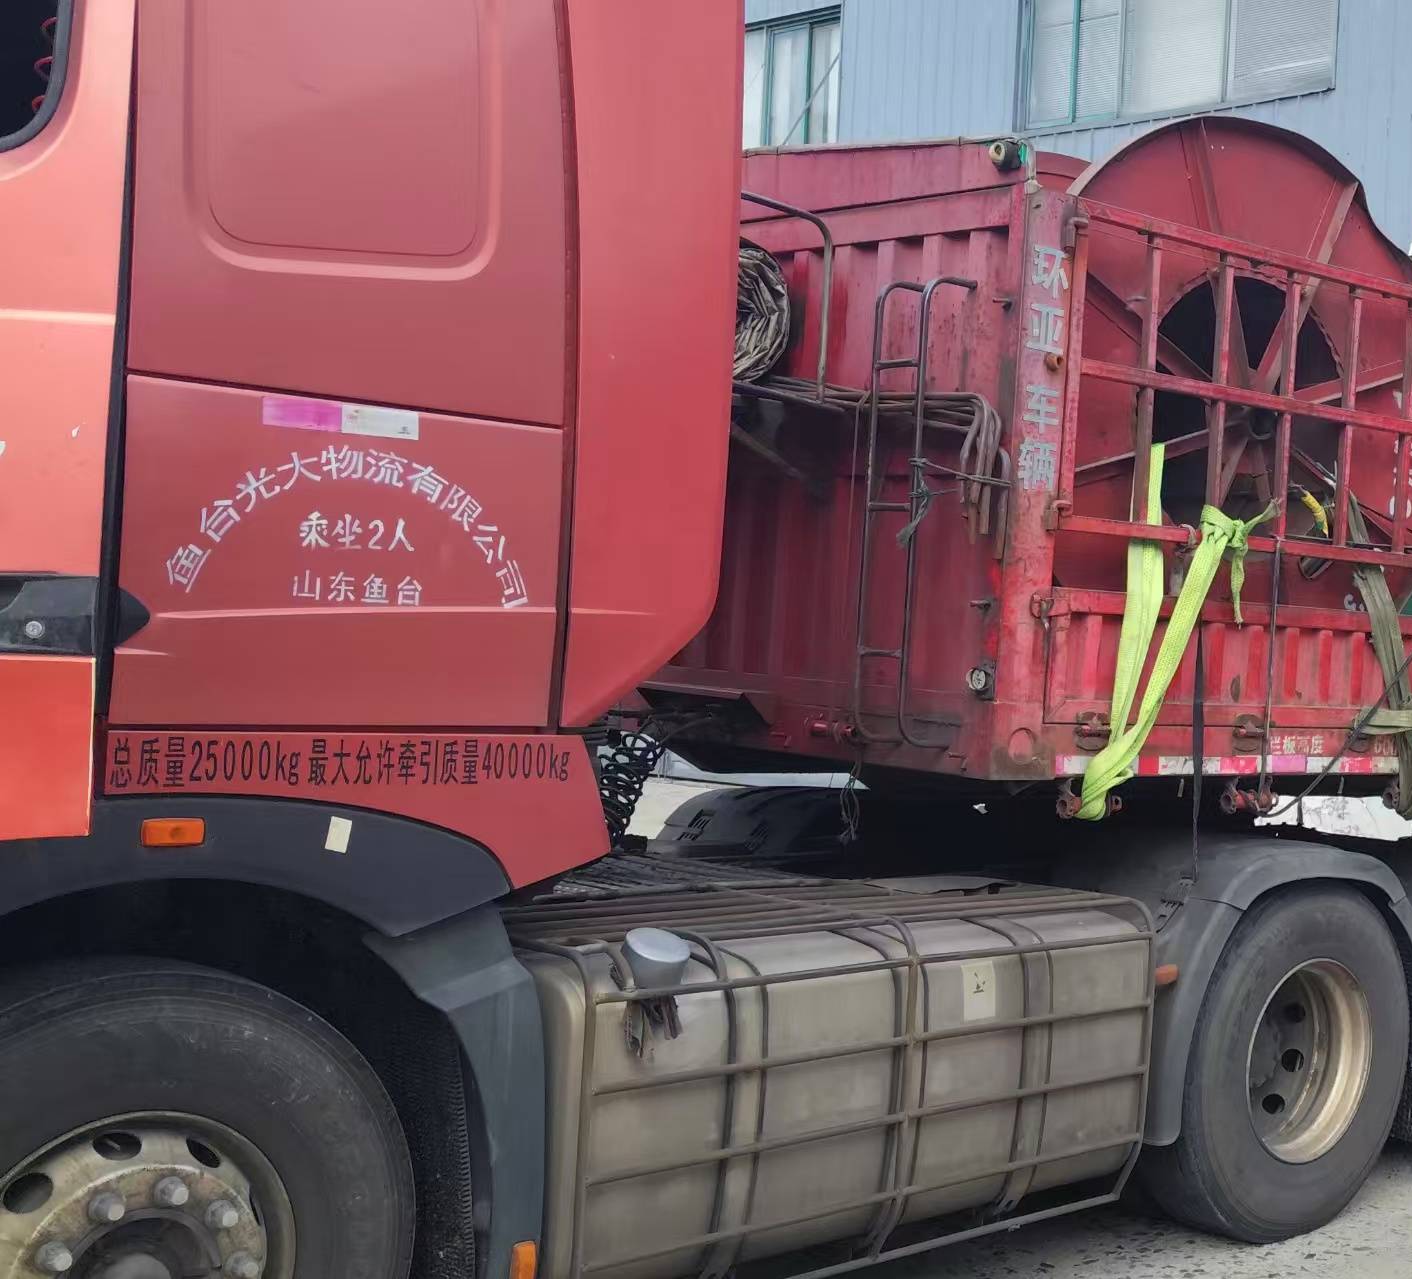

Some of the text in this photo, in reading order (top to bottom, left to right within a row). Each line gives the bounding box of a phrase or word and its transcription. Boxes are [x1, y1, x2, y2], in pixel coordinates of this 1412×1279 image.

[1018, 244, 1069, 490] 环亚车辆
[166, 445, 528, 609] 鱼台光大物流有限公司
[299, 511, 415, 552] 乘坐2人
[292, 570, 422, 606] 山东鱼台
[110, 736, 571, 788] 总质量25000kg 最大允许牵引质量40000kg
